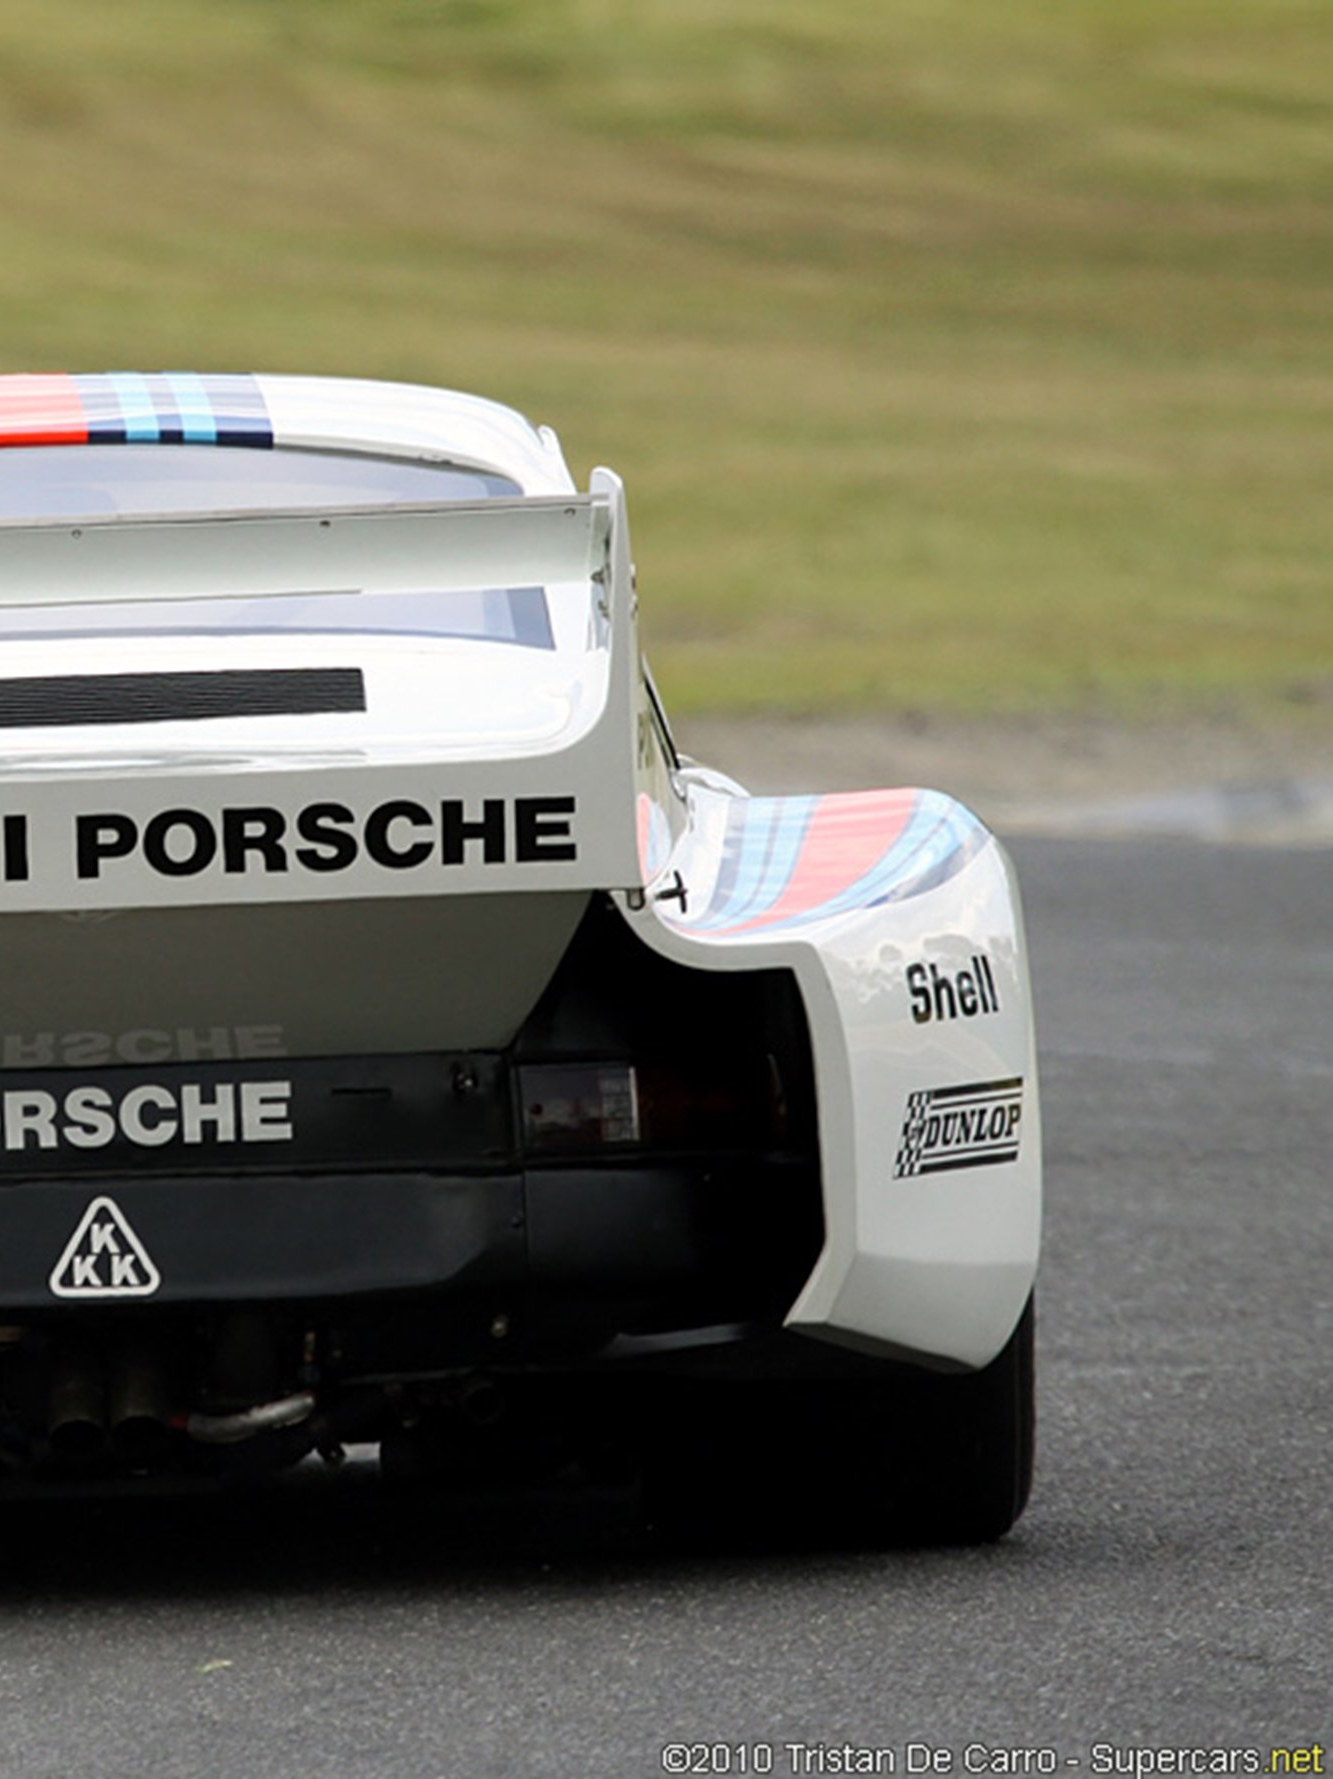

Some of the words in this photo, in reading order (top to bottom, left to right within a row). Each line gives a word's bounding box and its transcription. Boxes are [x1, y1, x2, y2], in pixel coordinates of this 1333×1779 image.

[76, 796, 578, 880] PORSCHE
[905, 954, 1000, 1024] Shell
[922, 1103, 1022, 1150] DUNLOP
